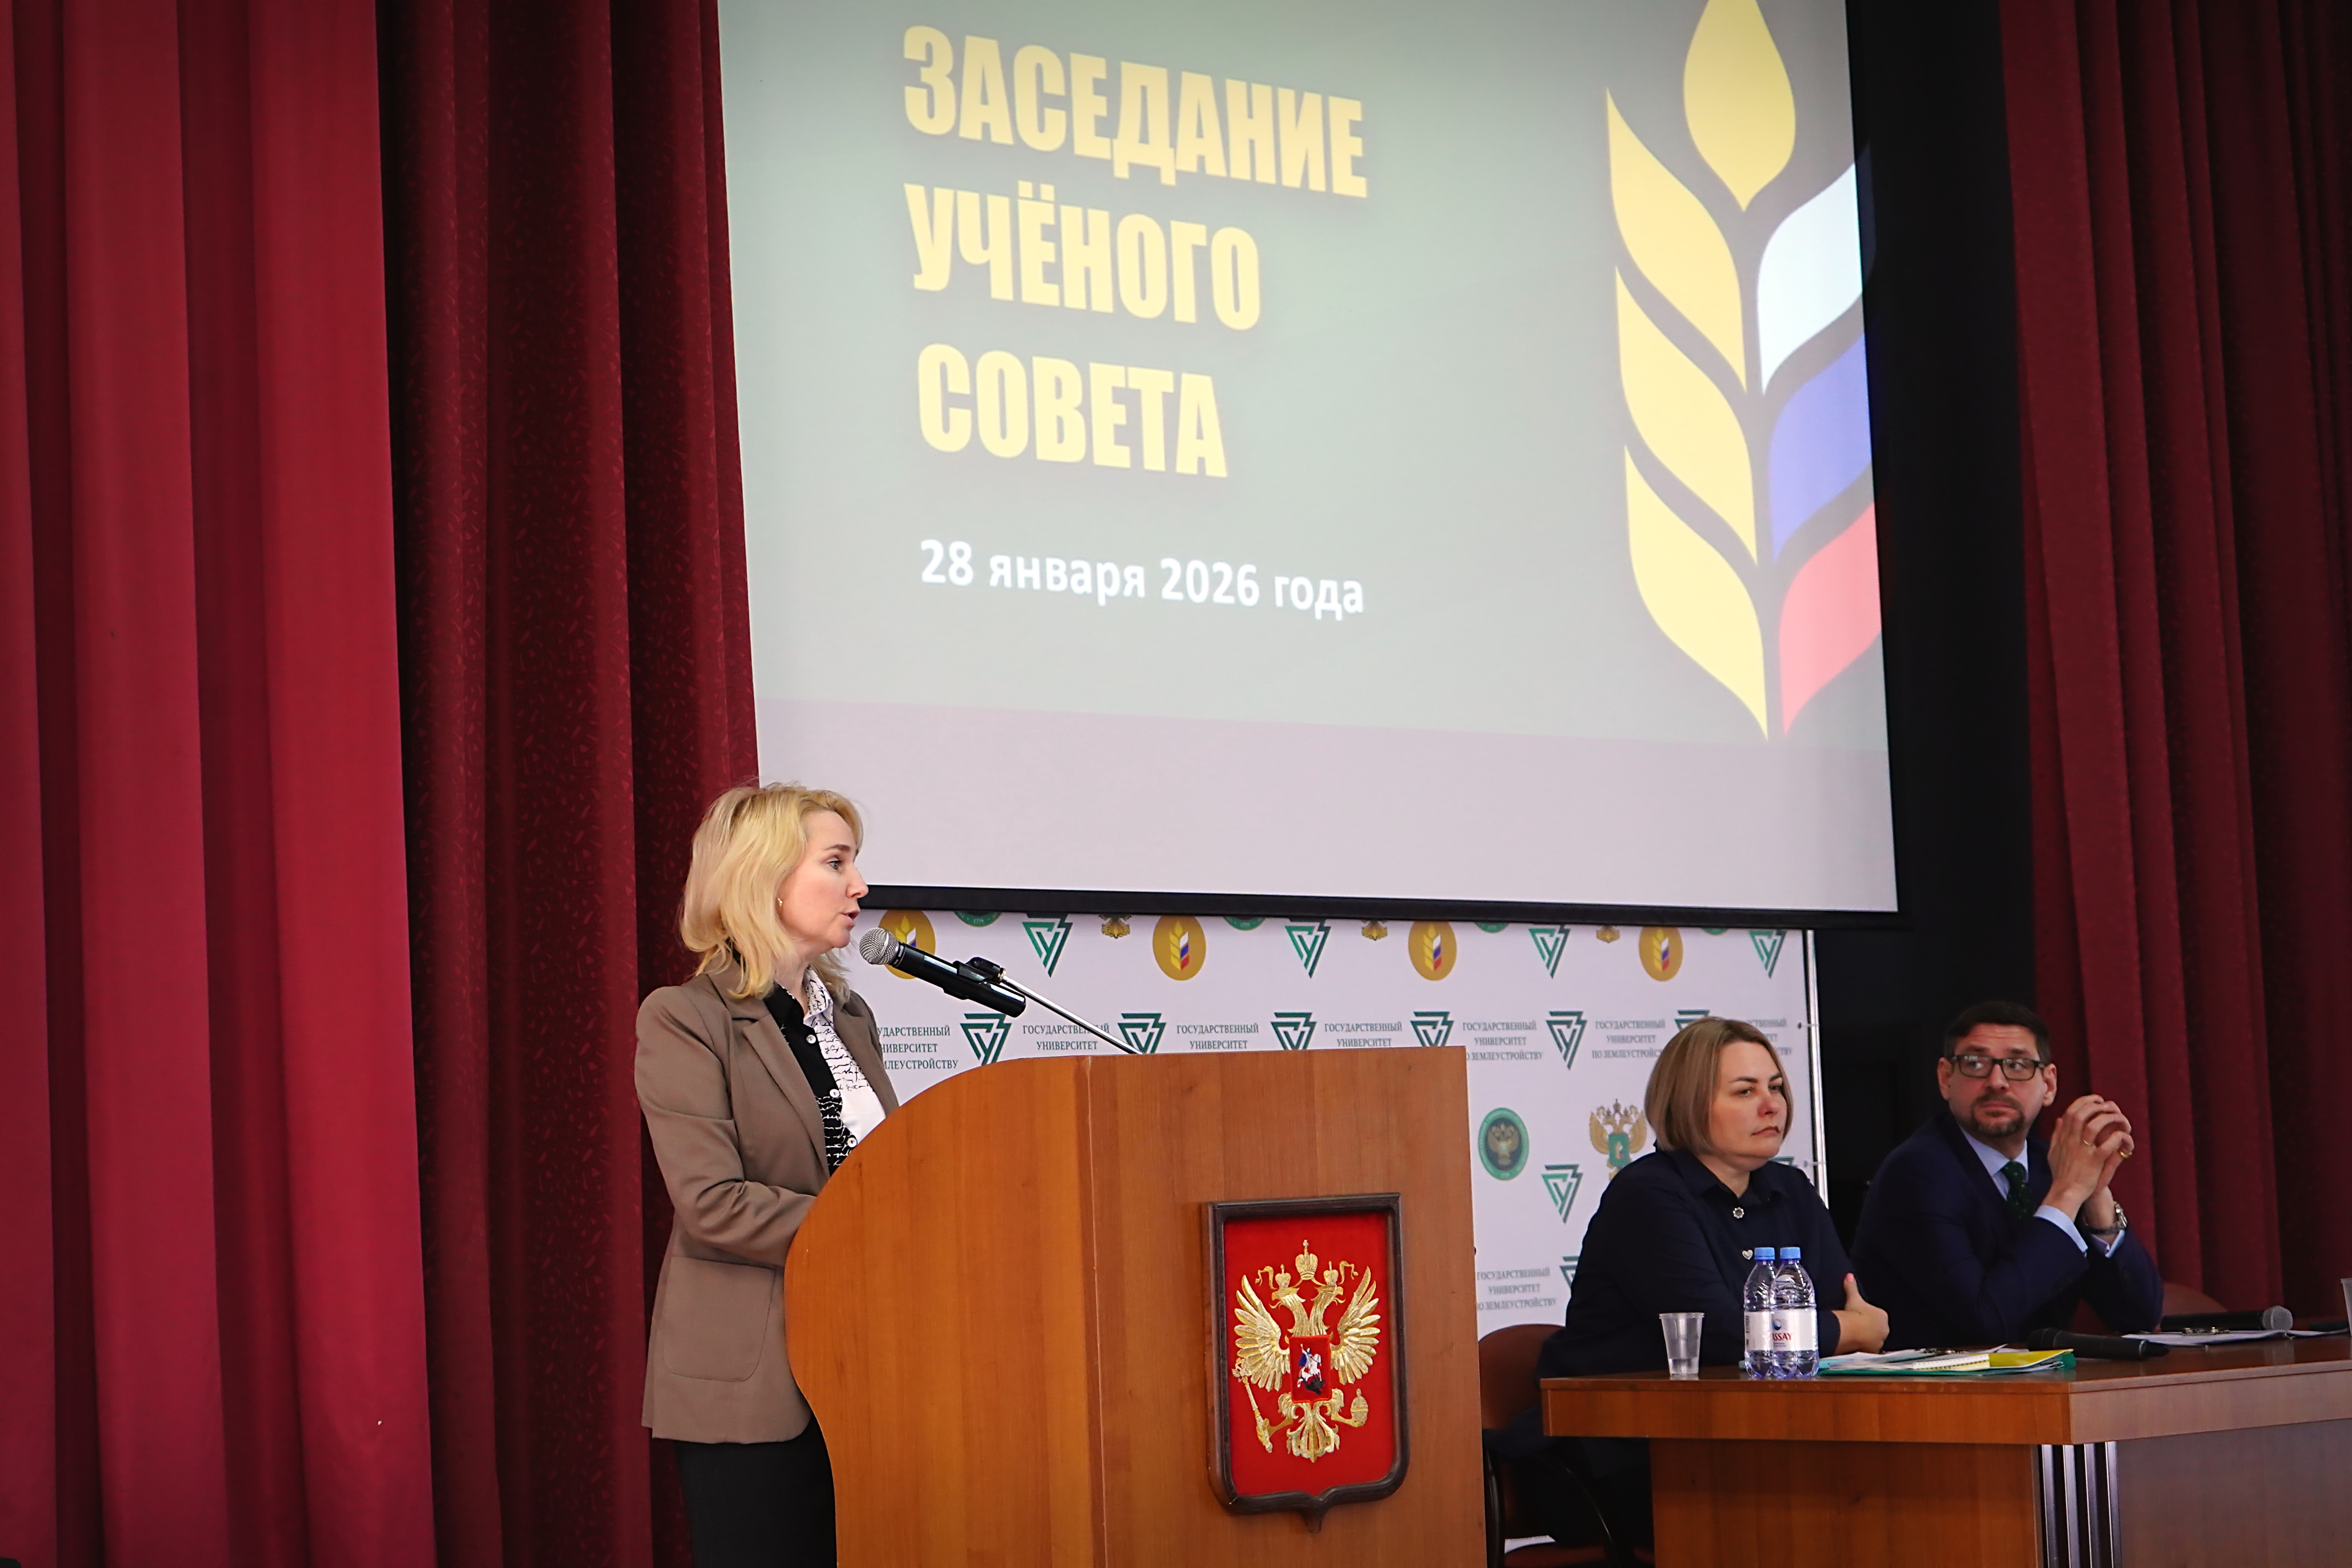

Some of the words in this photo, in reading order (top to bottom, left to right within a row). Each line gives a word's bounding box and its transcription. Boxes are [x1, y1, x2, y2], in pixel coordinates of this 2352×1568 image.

[904, 25, 1367, 198] ЗАСЕДАНИЕ
[904, 180, 1261, 331] УЧЁНОГО
[917, 343, 1228, 478] СОВЕТА
[920, 539, 974, 587] 28
[988, 554, 1145, 606] января
[1160, 558, 1260, 607] 2026
[1273, 575, 1364, 622] года
[1176, 1023, 1259, 1035] ГОСУДАРСТВЕННЫЙ
[1324, 1021, 1402, 1033] ГОСУДАРСТВЕННЫЙ
[1463, 1020, 1537, 1031] ГОСУДАРСТВЕННЫЙ
[877, 1025, 951, 1038] УДАРСТВЕННЫЙ
[1037, 1041, 1098, 1050] УНИВЕРСИТЕТ
[1190, 1040, 1248, 1049] УНИВЕРСИТЕТ
[1337, 1038, 1392, 1047] УНИВЕРСИТЕТ
[1475, 1037, 1526, 1045] УНИВЕРСИТЕТ
[882, 1043, 938, 1053] НИВЕРСИТЕТ
[1472, 1050, 1543, 1060] ЗЕМЛЕУСТРОЙСТВУ
